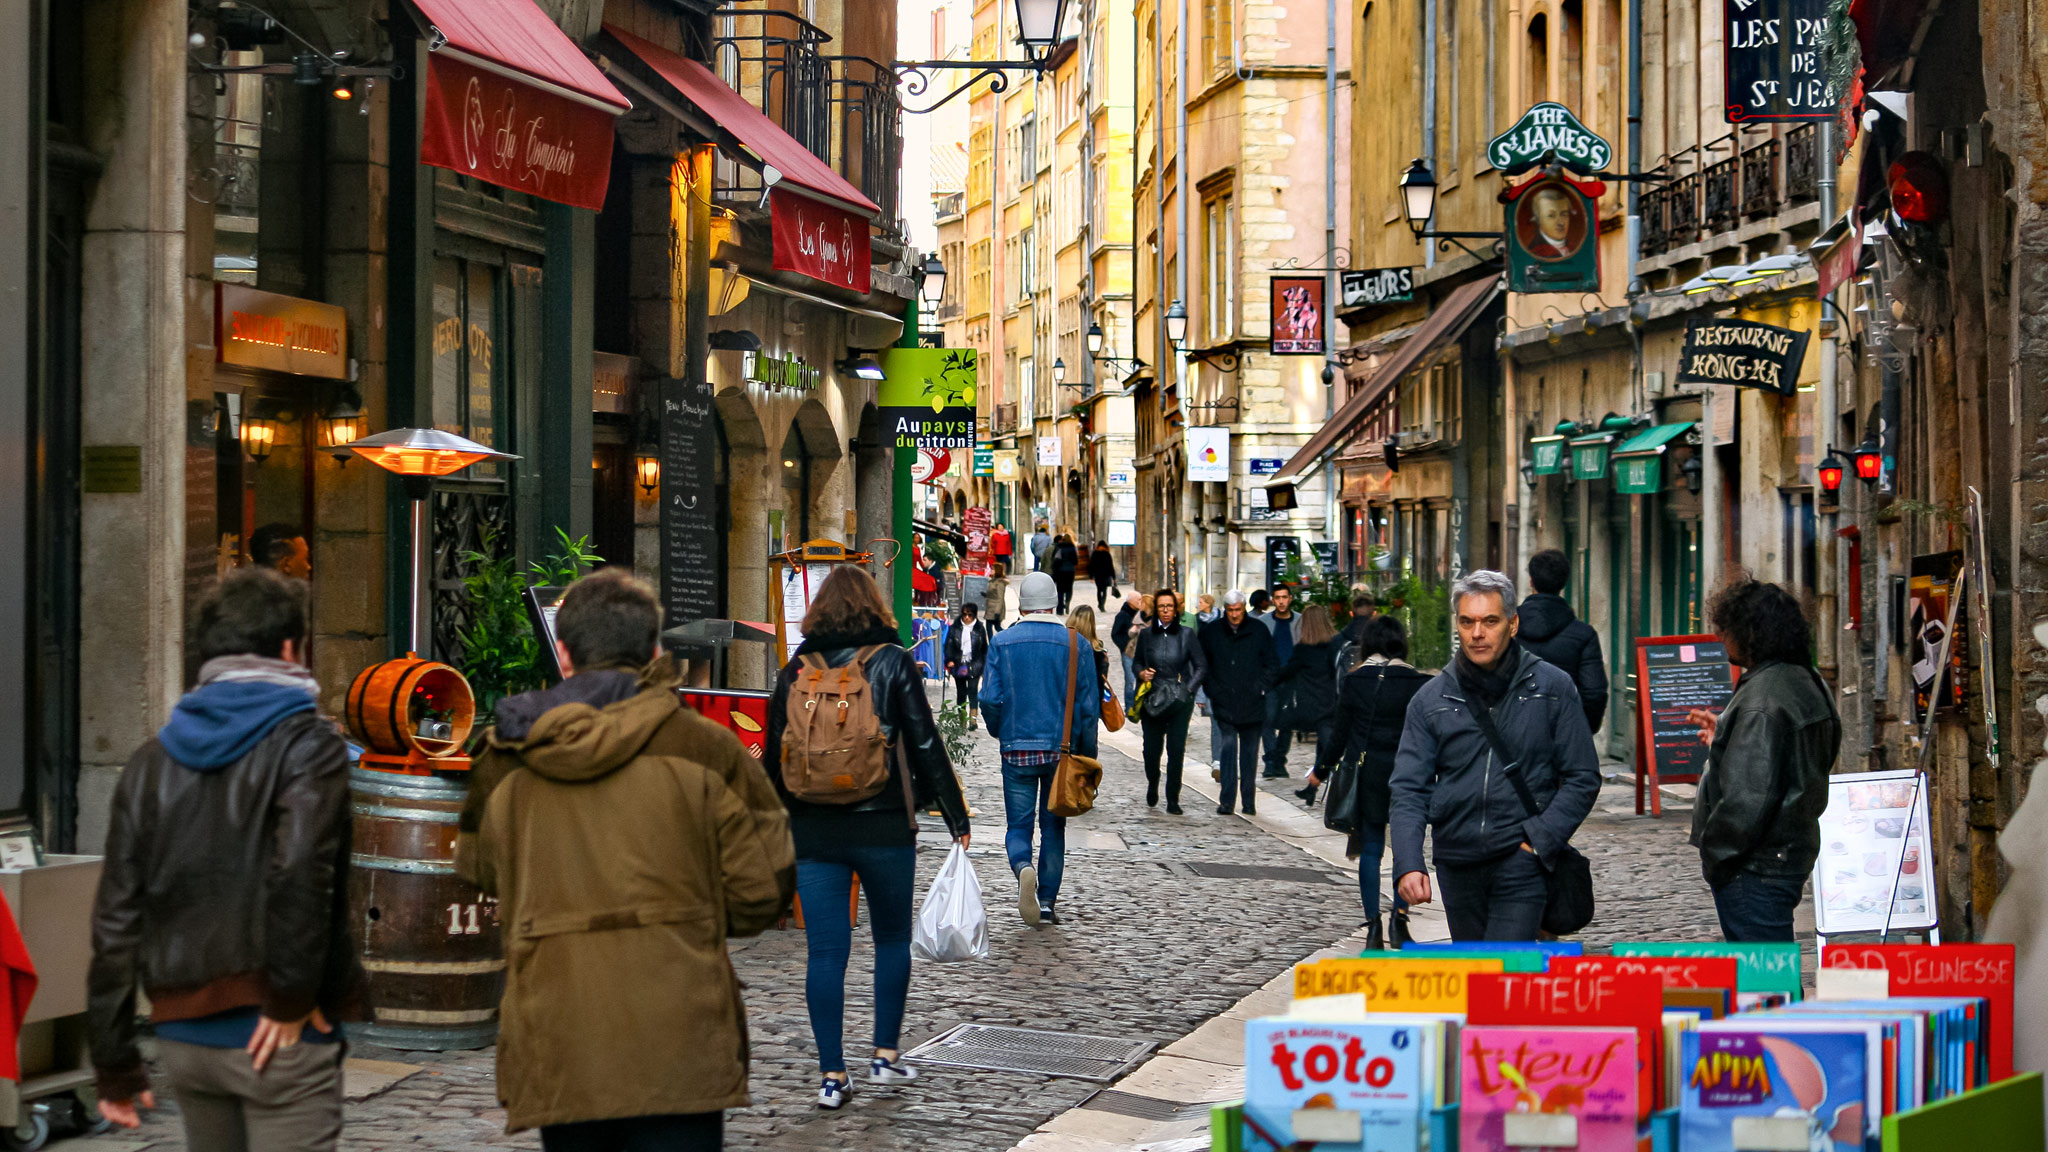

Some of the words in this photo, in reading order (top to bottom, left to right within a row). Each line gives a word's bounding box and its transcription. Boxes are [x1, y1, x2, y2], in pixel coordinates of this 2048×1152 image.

[1731, 19, 1780, 48] LES
[1791, 52, 1816, 74] DE
[1787, 79, 1836, 108] JEA
[1528, 107, 1567, 126] THE
[519, 116, 576, 191] Comptoir
[1693, 326, 1794, 356] RESTAURANT
[446, 903, 481, 934] 11
[1298, 968, 1377, 1000] BLAGUES
[1405, 970, 1461, 1000] TOTO
[1897, 951, 2013, 985] JEUNESSE
[1498, 975, 1617, 1014] TITEUF
[1271, 1031, 1396, 1091] toto
[1467, 1036, 1626, 1097] titeuf
[1690, 1051, 1773, 1097] APPA
